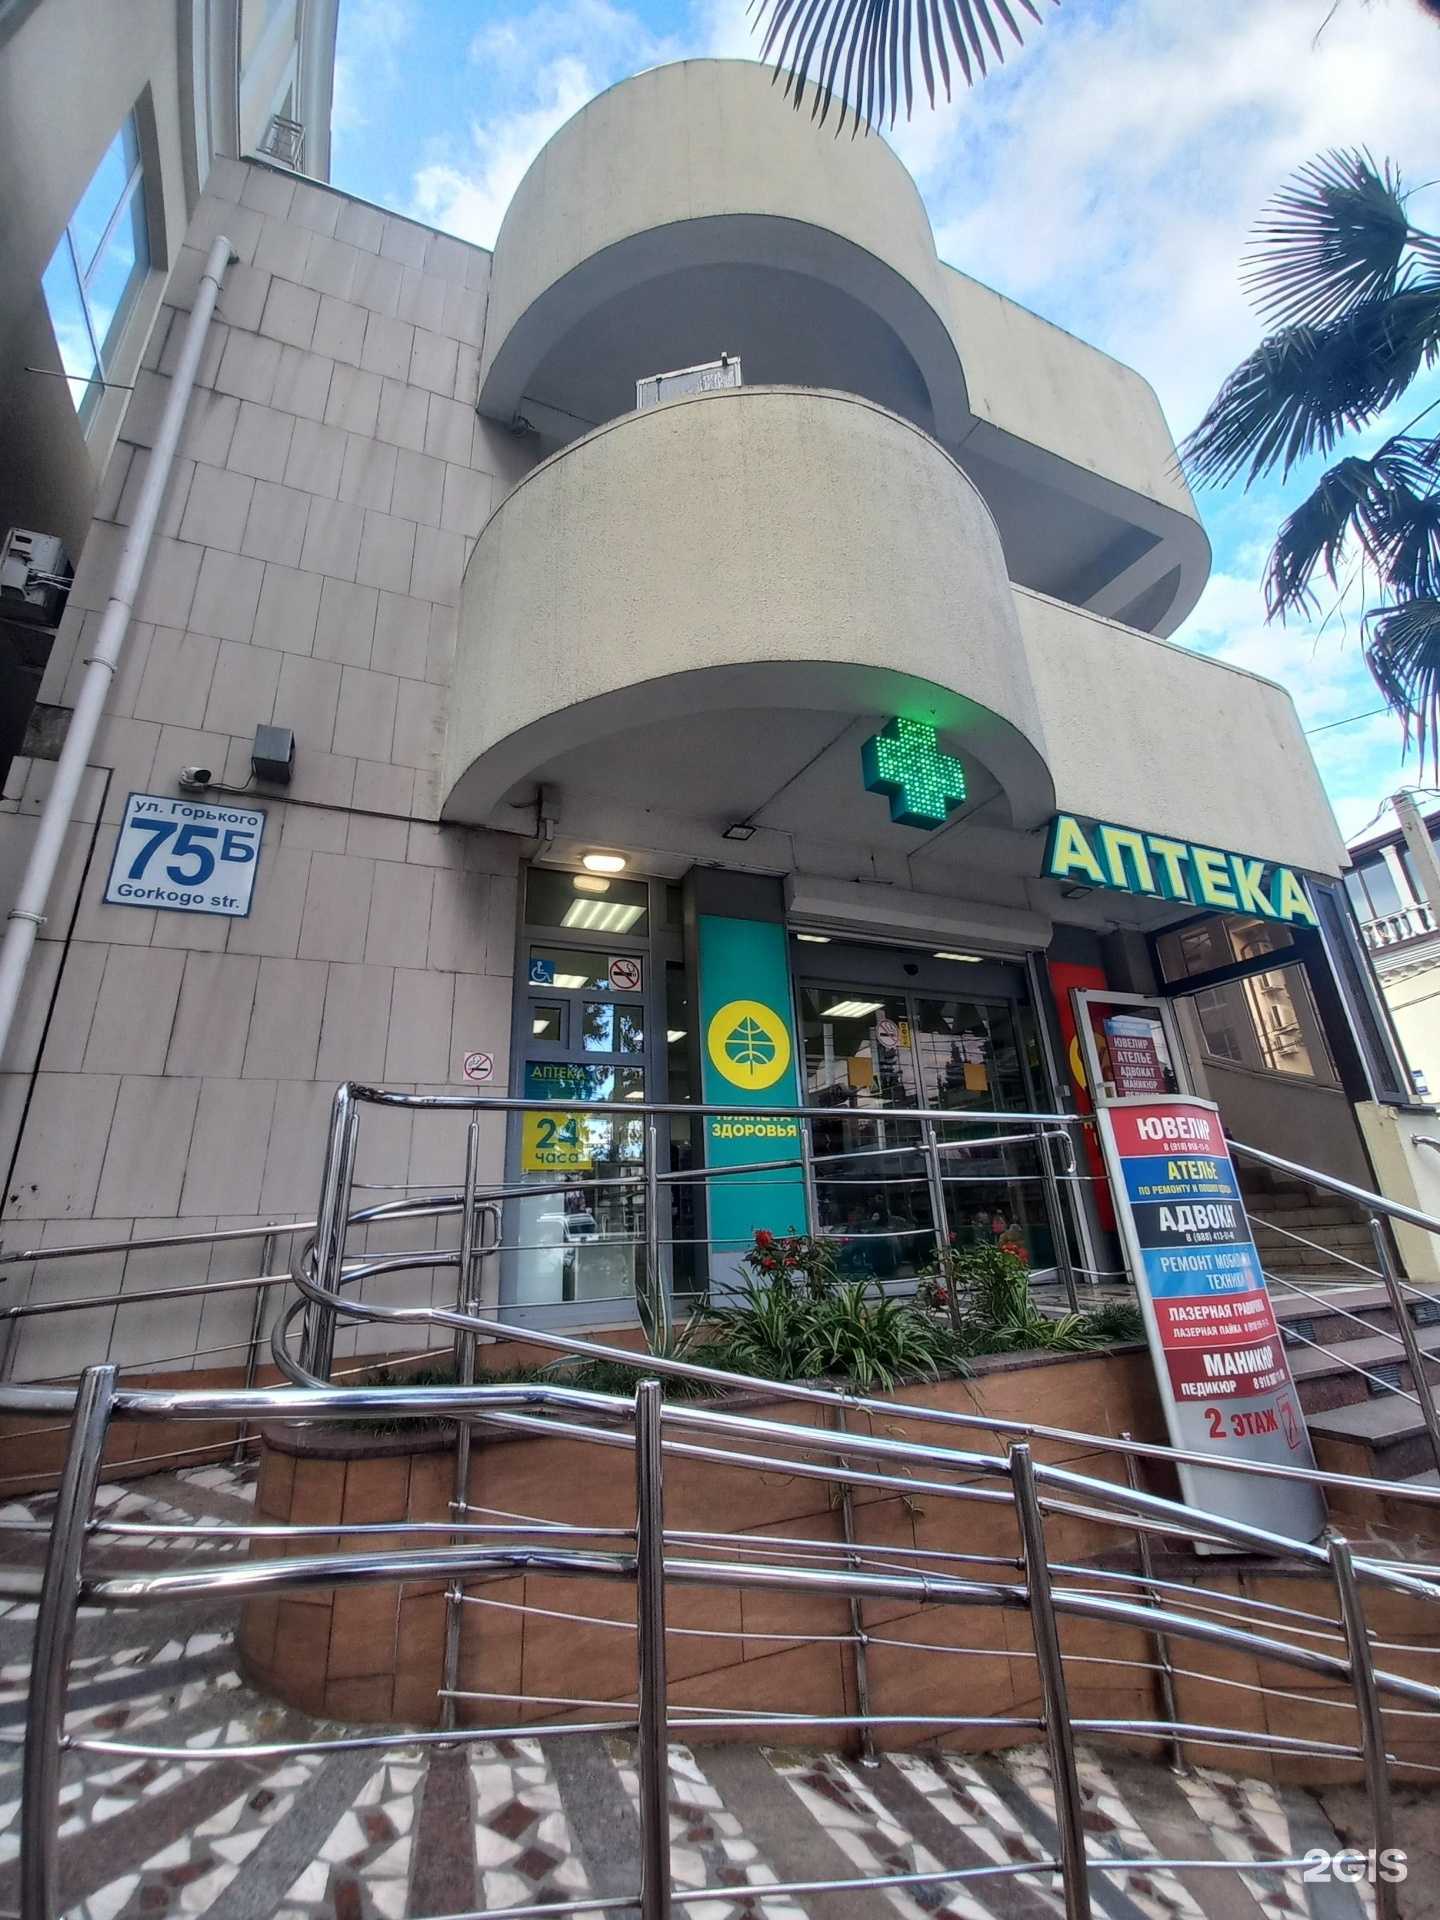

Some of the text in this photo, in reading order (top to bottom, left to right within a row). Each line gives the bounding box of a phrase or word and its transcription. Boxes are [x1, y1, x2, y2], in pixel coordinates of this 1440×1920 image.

[134, 801, 258, 826] ул. Горького
[1050, 815, 1320, 927] АПТЕКА
[117, 884, 240, 909] Gorkogo str.
[1113, 1037, 1148, 1049] ЮВЕЛИР
[1117, 1051, 1152, 1064] АТЕЛЬЕ
[531, 1066, 585, 1079] АПТЕКА
[1120, 1066, 1155, 1079] АДВОКАТ
[1122, 1080, 1158, 1089] МАНИКЮР
[535, 1118, 577, 1149] 24
[711, 1123, 797, 1139] ЗДОРОВЬЯ
[1136, 1117, 1210, 1140] ЮВЕЛИР
[535, 1152, 579, 1164] часа
[1167, 1160, 1218, 1180] АТЕЛЬЕ
[1138, 1185, 1151, 1195] ПО
[1152, 1184, 1191, 1195] РЕМОНТУ
[1160, 1204, 1237, 1232] АДВОКАТ
[1160, 1255, 1213, 1273] РЕМОНТ
[1168, 1304, 1232, 1321] ЛАЗЕРНАЯ
[1173, 1326, 1218, 1338] ЛАЗЕРНАЯ
[1219, 1323, 1242, 1335] ПАЙКА
[1202, 1345, 1274, 1377] МАНИКЮР
[1180, 1380, 1237, 1397] ПЕДИКЮР
[1204, 1407, 1278, 1438] 2 ЭТАЖ
